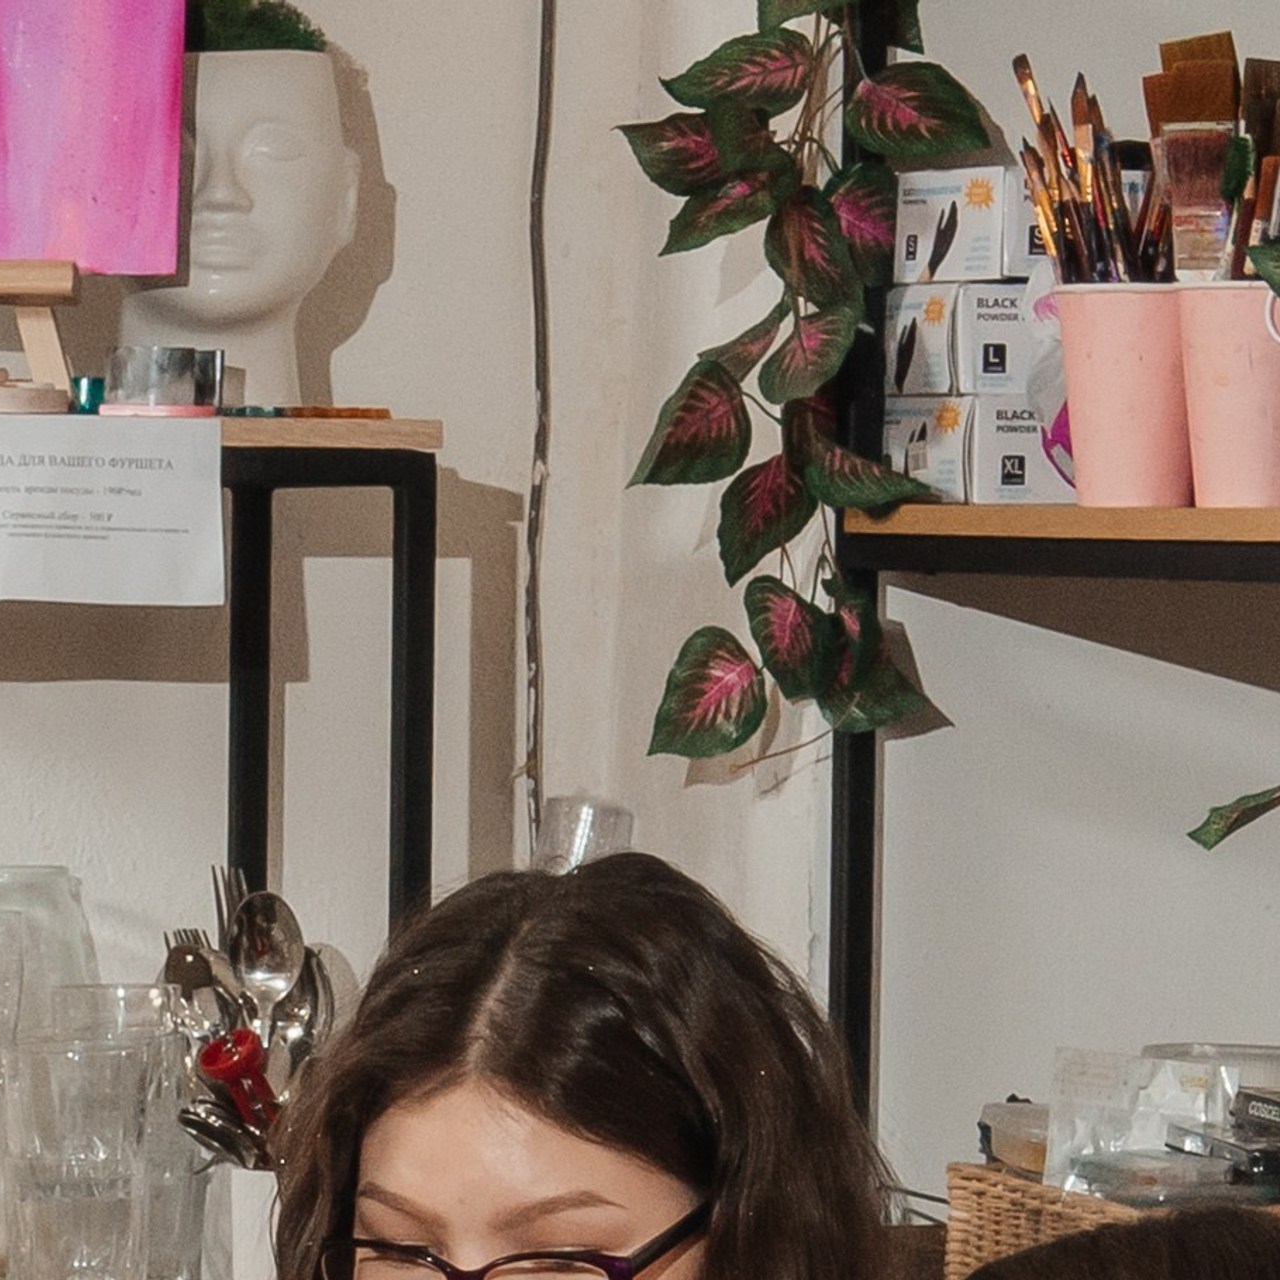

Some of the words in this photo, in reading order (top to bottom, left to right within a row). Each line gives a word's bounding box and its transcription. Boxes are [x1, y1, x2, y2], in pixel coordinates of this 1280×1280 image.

[1033, 227, 1045, 245] S
[976, 297, 1018, 309] BLACK
[976, 313, 1019, 322] POWDER
[988, 345, 1000, 363] L
[995, 409, 1036, 421] BLACK
[995, 425, 1038, 434] POWDER
[17, 454, 45, 467] ДЛЯ
[48, 455, 106, 468] ВАШЕГО
[108, 457, 175, 470] ФУРШЕТА
[1003, 458, 1023, 475] XL
